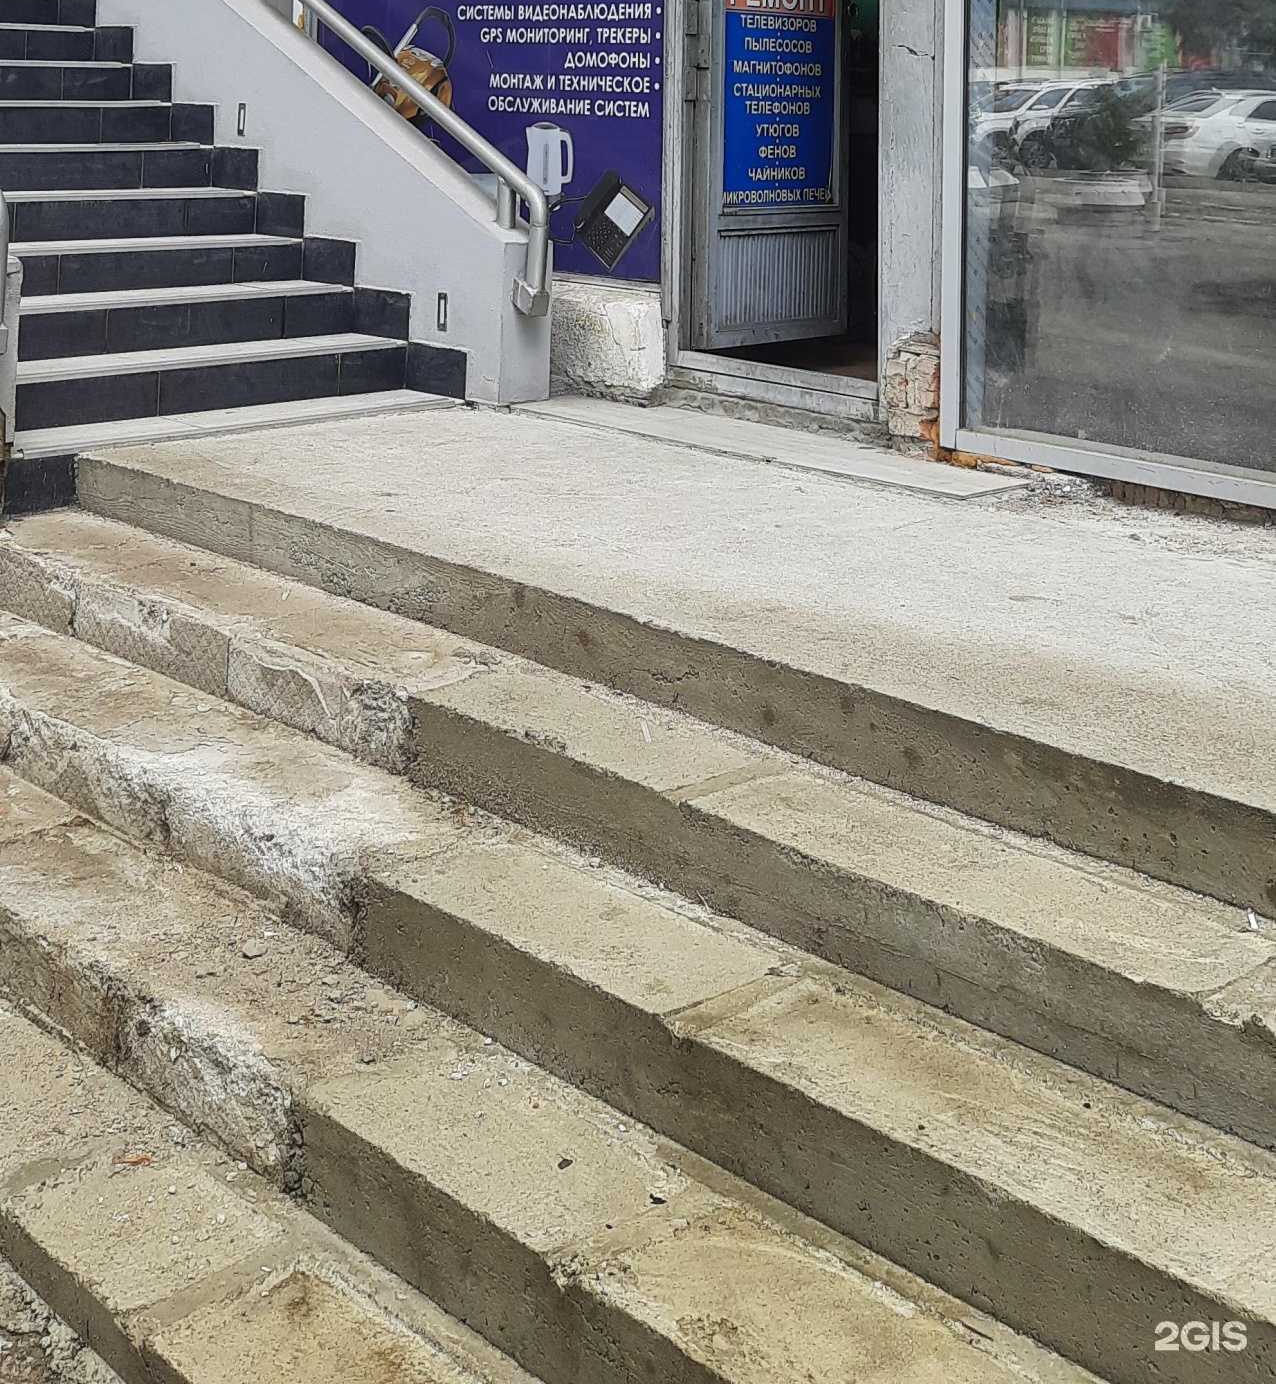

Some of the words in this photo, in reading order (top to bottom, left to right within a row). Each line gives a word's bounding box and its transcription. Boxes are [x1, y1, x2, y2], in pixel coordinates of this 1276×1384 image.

[457, 5, 514, 21] СИСТЕМЫ
[518, 3, 652, 22] ВИДЕОНАБЛЮДЕНИЯ
[740, 14, 817, 33] ТЕЛЕВИЗОРОВ
[480, 28, 503, 43] GPS
[506, 28, 593, 45] МОНИТОРИНГ,
[597, 28, 651, 44] ТРЕКЕРЫ
[744, 37, 813, 54] ПЫЛЕСОСОВ
[564, 52, 651, 69] ДОМОФОНЫ
[733, 59, 822, 76] МАГНИТОФОНОВ
[489, 74, 544, 90] МОНТАЖ
[547, 75, 556, 90] И
[559, 75, 650, 93] ТЕХНИЧЕСКОЕ
[733, 83, 821, 99] СТАЦИОНАРНЫХ
[488, 96, 591, 115] ОБСЛУЖИВАНИЕ
[595, 100, 650, 117] СИСТЕМ
[745, 100, 811, 115] ТЕЛЕФОНОВ
[756, 123, 800, 137] УТЮГОВ
[758, 144, 797, 159] ФЕНОВ
[748, 165, 806, 182] ЧАЙНИКОВ
